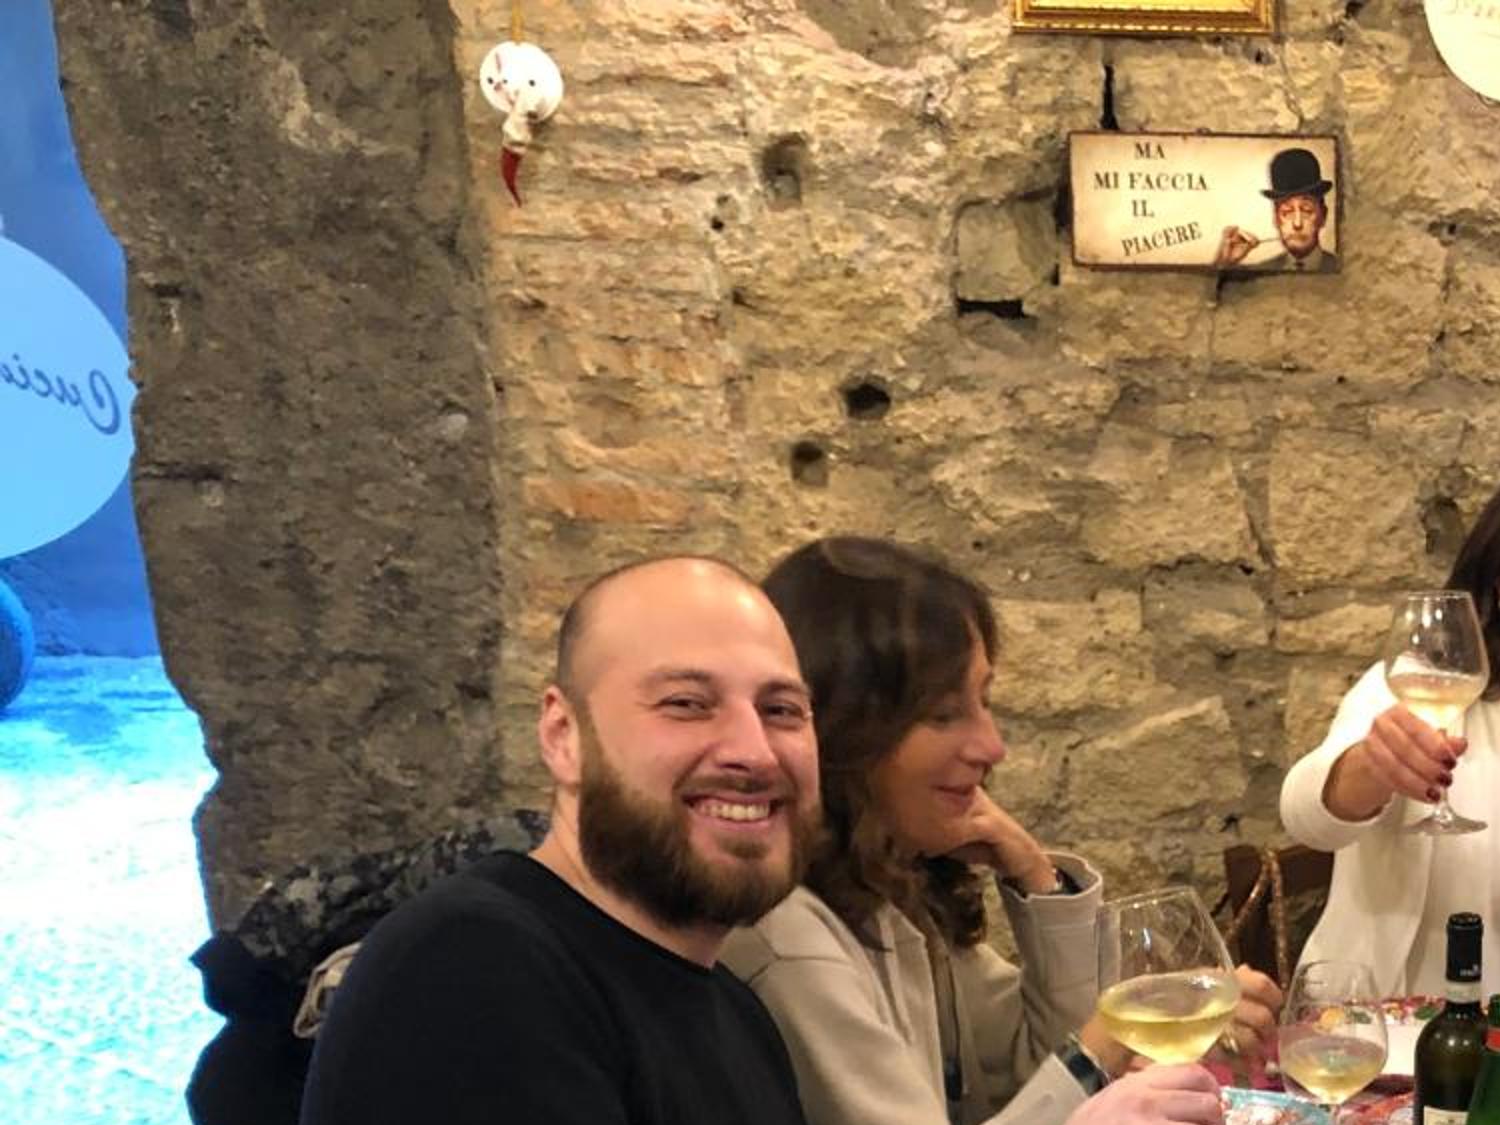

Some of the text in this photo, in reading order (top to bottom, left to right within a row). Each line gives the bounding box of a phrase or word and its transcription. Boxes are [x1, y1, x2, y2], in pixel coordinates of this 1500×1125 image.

[1134, 142, 1166, 160] MA
[1093, 172, 1209, 192] MI FACCIA
[1131, 199, 1154, 218] IL
[1121, 222, 1203, 257] PIACERE
